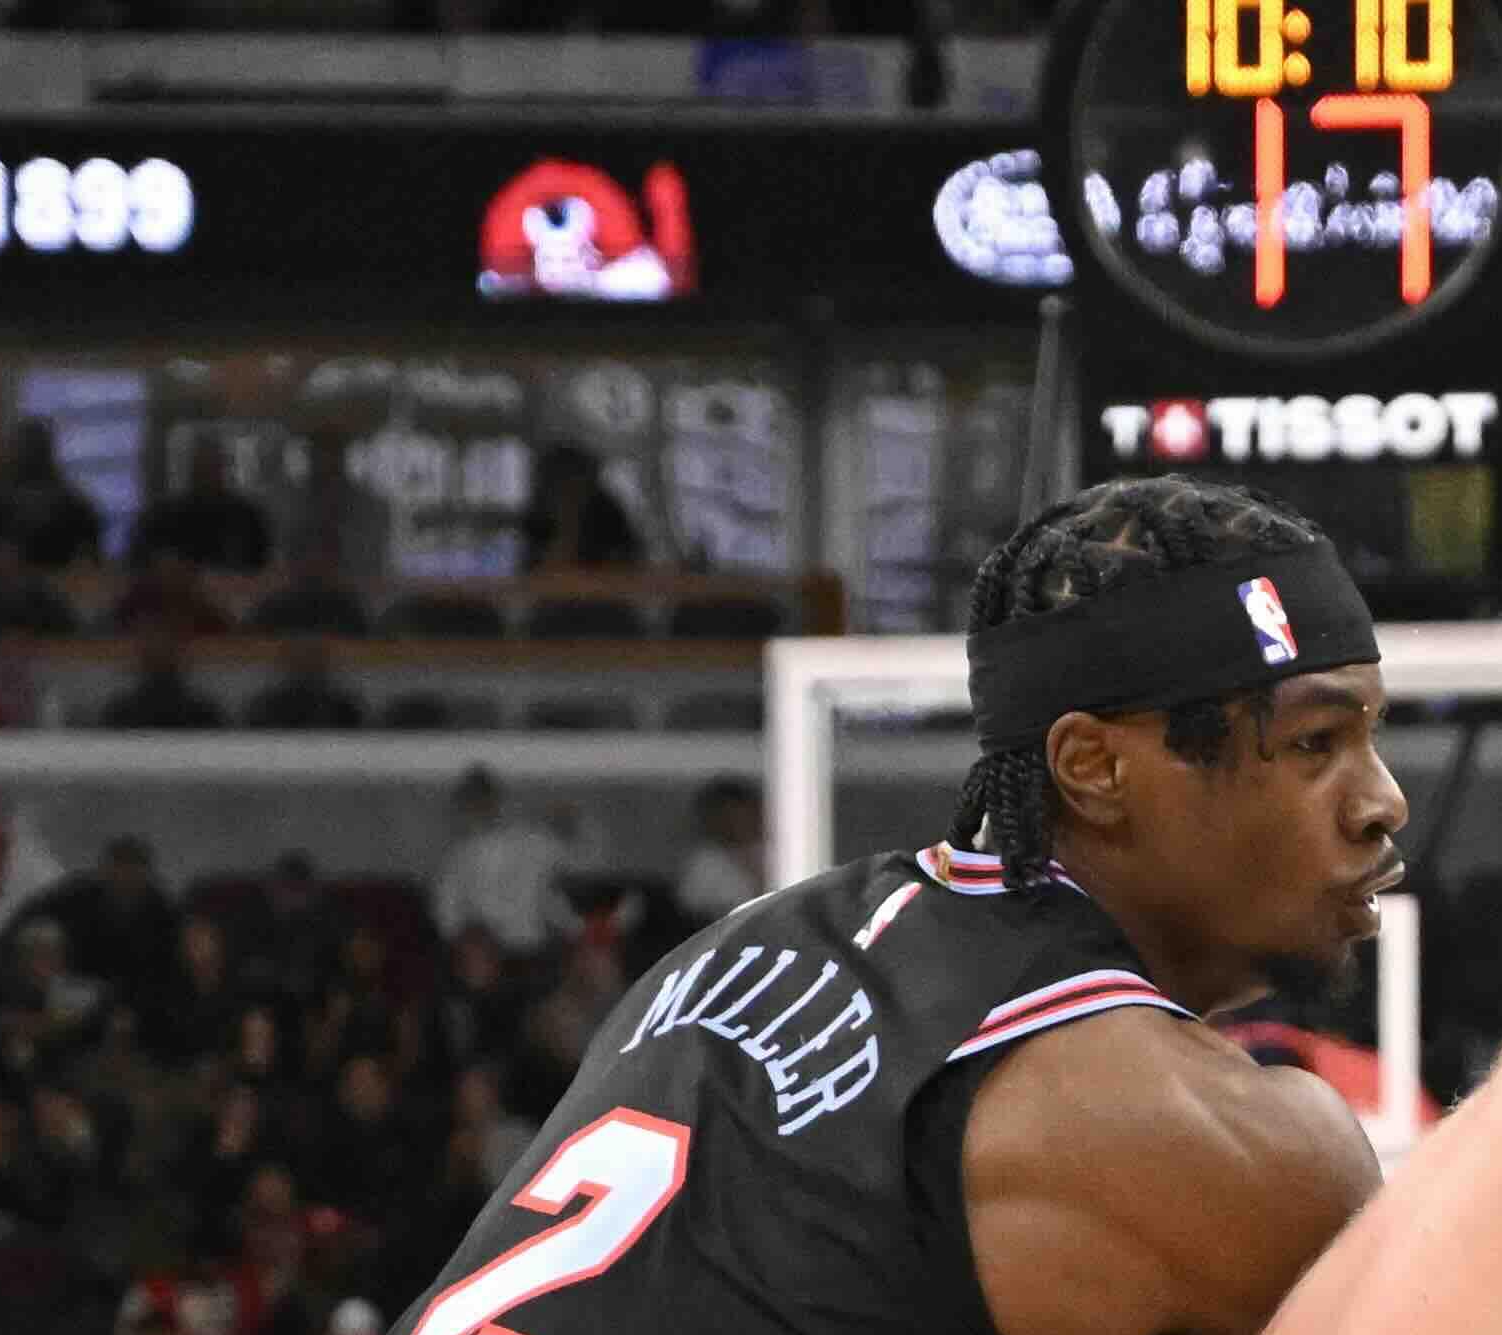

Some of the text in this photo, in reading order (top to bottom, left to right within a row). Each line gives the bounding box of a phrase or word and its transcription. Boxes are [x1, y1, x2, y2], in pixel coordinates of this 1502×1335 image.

[1186, 0, 1454, 96] 10:10
[1255, 94, 1431, 309] 17
[1206, 391, 1498, 462] TISSOT
[619, 946, 879, 1136] MILLER
